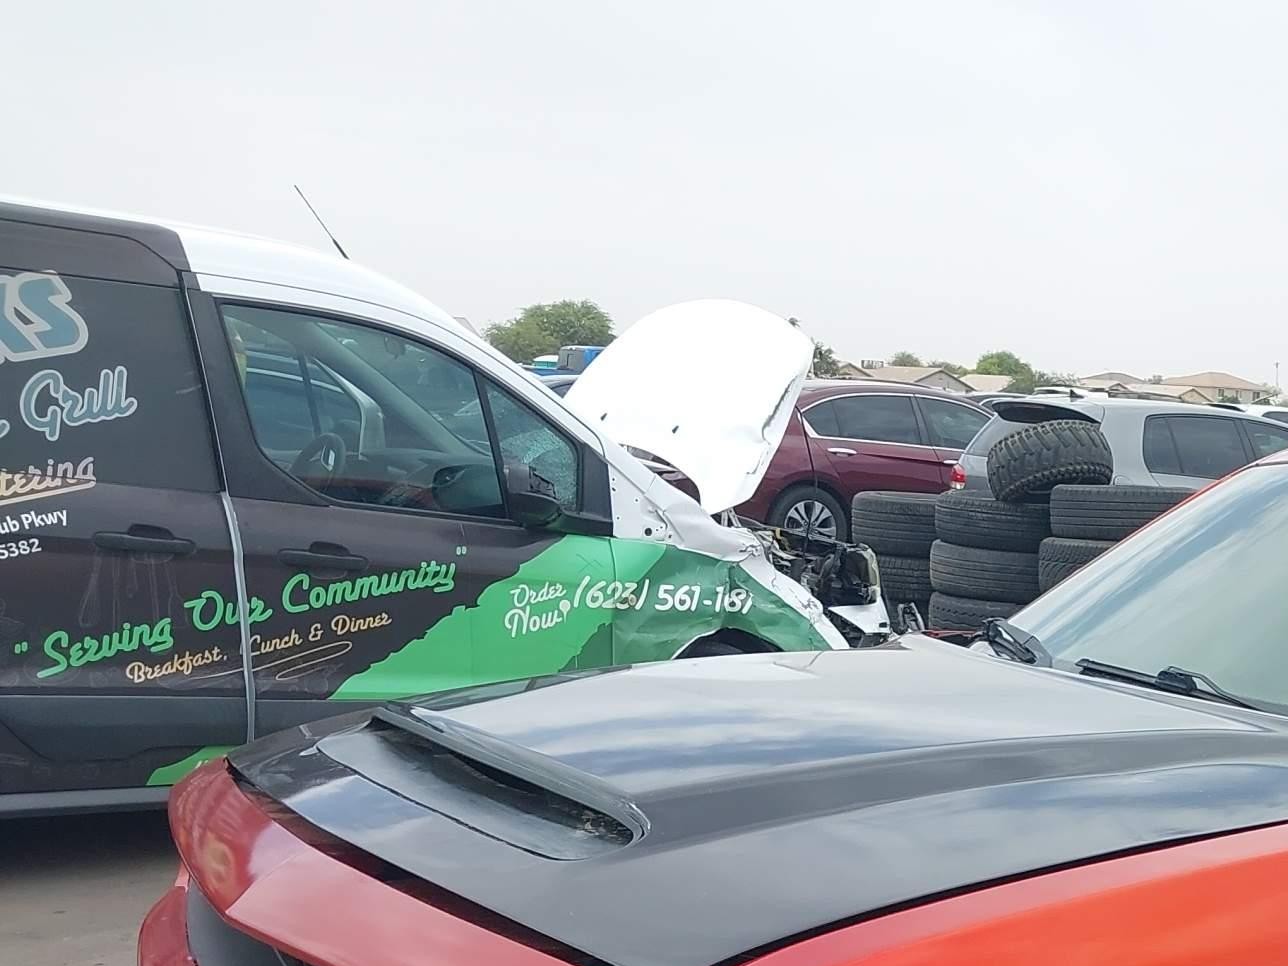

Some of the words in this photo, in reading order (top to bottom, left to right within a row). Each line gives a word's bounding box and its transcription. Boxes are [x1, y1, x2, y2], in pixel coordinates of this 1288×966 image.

[20, 366, 138, 441] Grill
[20, 509, 67, 530] Pkwy
[0, 538, 42, 560] 5382
[510, 582, 567, 607] Order
[573, 575, 650, 610] (623)
[184, 590, 272, 631] Our
[308, 623, 324, 641] &
[331, 612, 393, 634] Dinner
